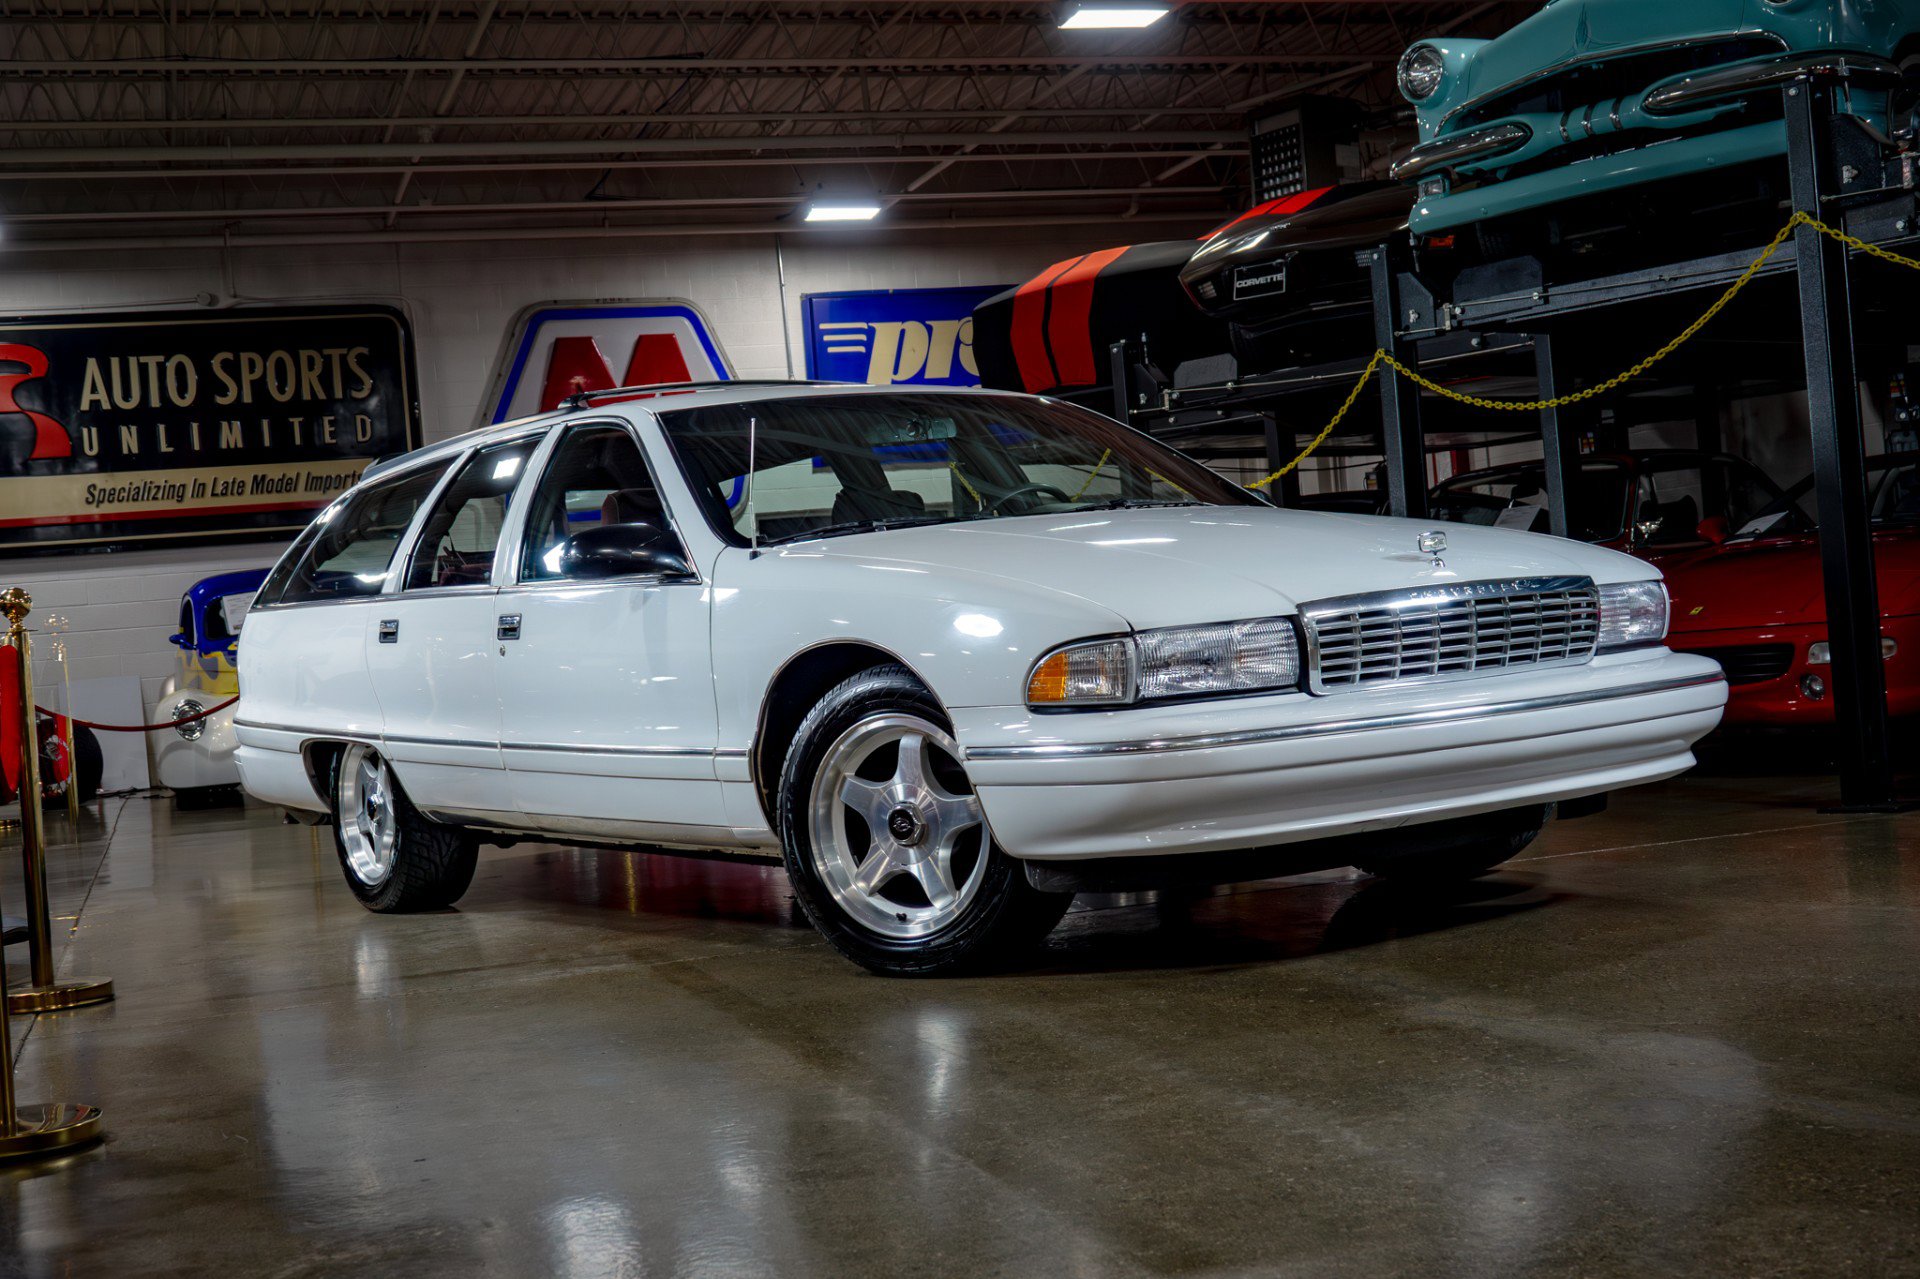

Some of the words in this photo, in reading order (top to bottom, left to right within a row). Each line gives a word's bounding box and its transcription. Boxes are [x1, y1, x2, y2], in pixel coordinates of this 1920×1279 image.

[1236, 273, 1283, 288] CORVETTE
[80, 354, 198, 412] AUTO
[211, 347, 374, 405] SPORTS
[82, 414, 373, 457] UNLIMITED
[85, 480, 185, 507] Specializing
[190, 477, 206, 498] In
[210, 477, 246, 497] Late
[250, 472, 301, 495] Model
